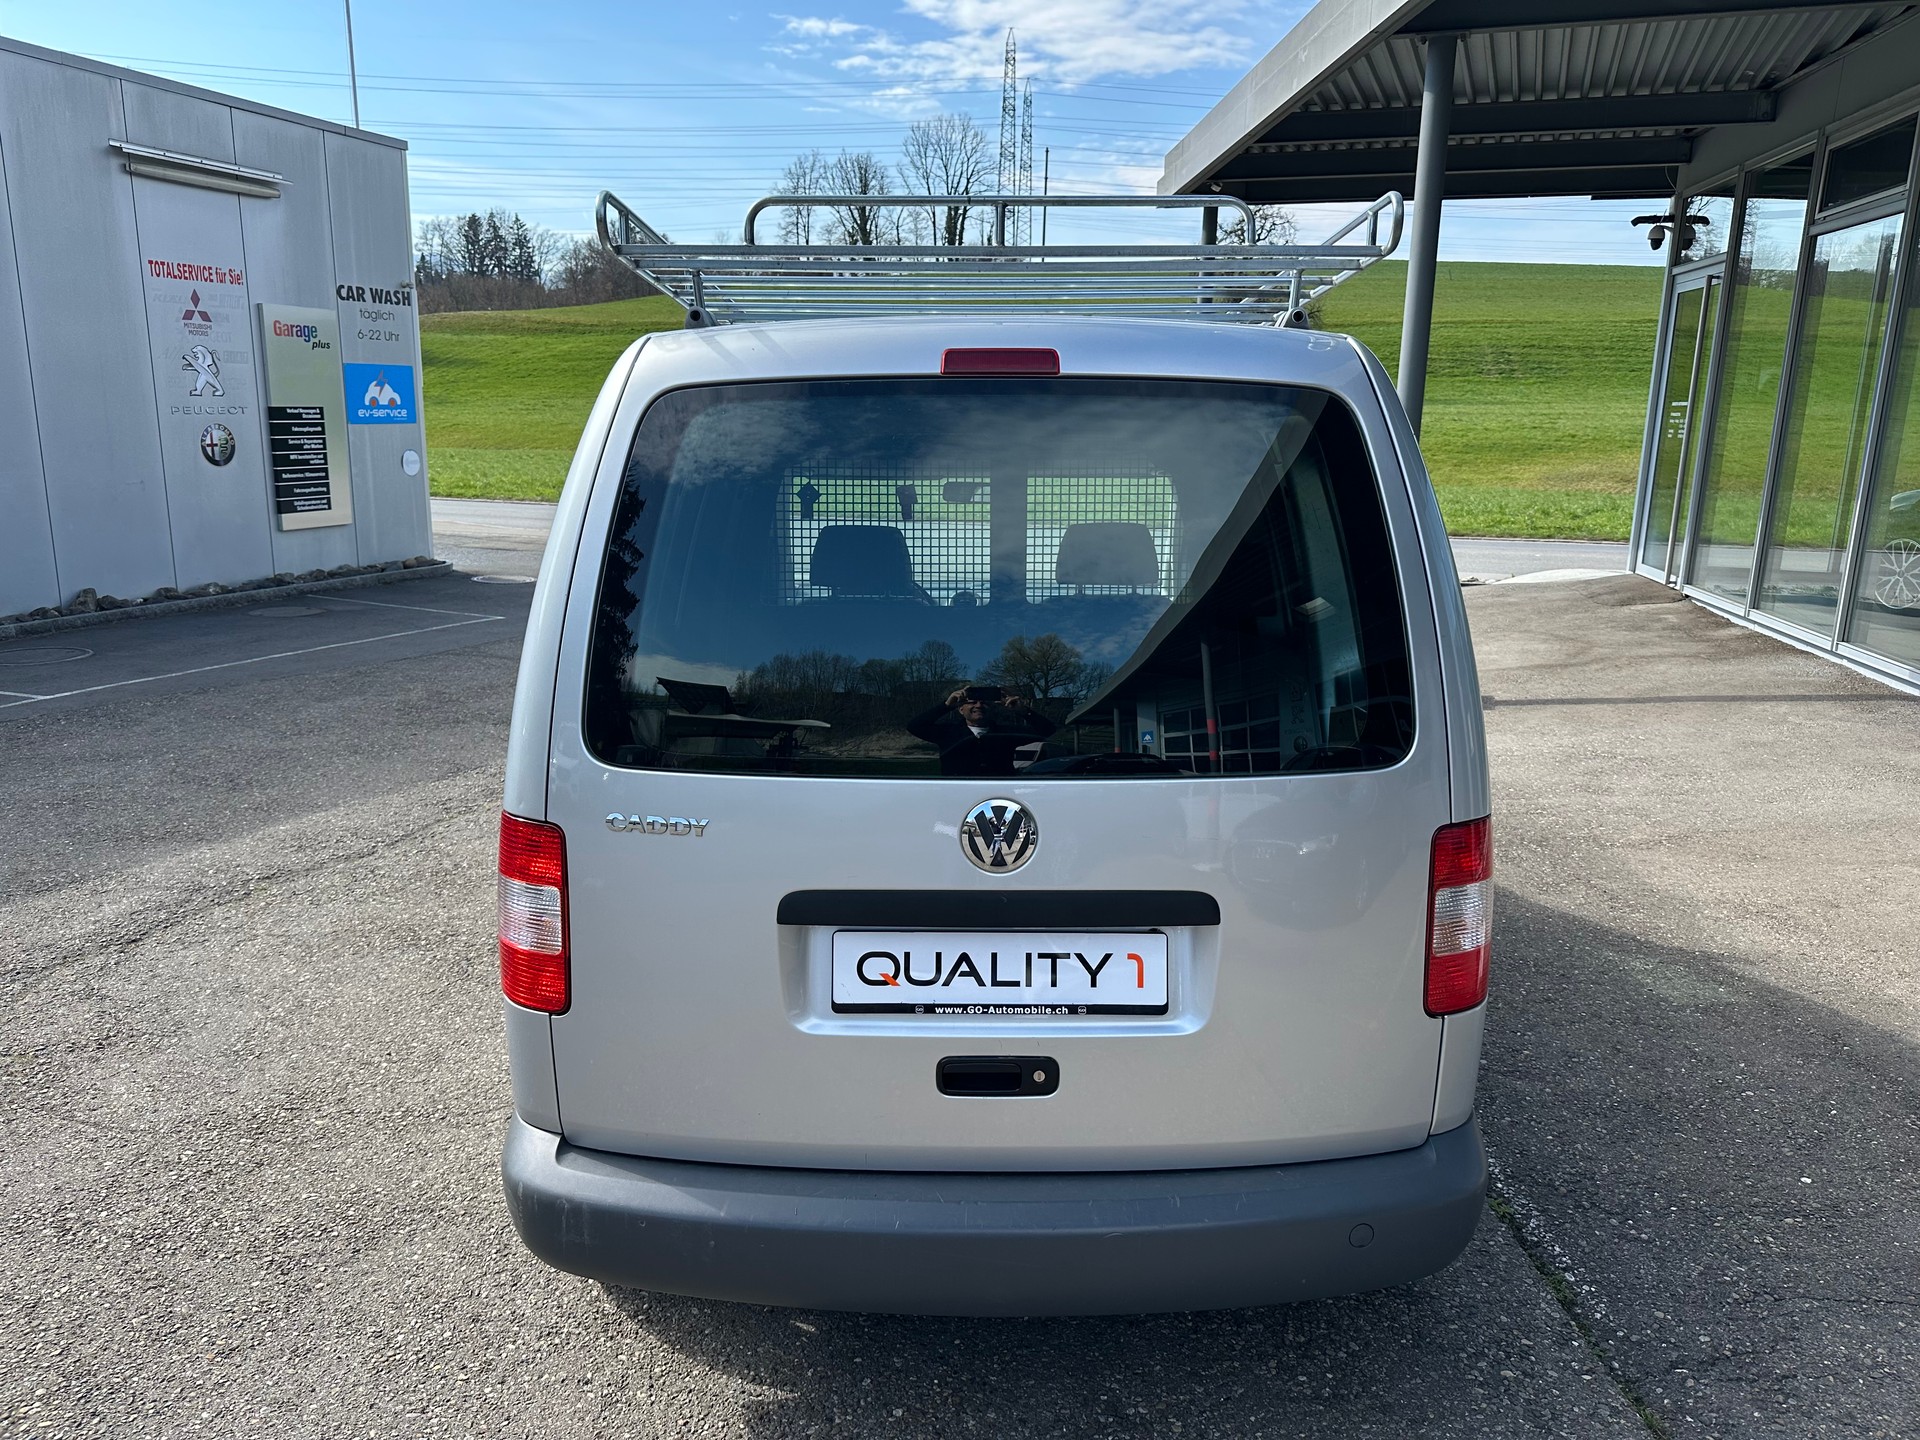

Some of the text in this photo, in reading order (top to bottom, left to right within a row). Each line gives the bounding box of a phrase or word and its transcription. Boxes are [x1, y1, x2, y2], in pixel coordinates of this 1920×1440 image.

[148, 260, 244, 285] TOTALSERVICE für Sie!
[337, 284, 411, 306] CAR WASH
[359, 309, 395, 322] täglich
[183, 322, 212, 331] MITSUBISHI
[188, 329, 209, 337] MOTORS
[273, 320, 318, 342] Garage
[357, 329, 400, 342] 6-22 Uhr
[312, 340, 331, 350] plus
[170, 405, 248, 415] PEUGEOT
[358, 408, 407, 418] ev-service
[605, 812, 710, 837] CADDY
[856, 950, 1144, 988] QUALITY 1
[935, 1005, 1069, 1015] www.GO-Automobile.ch
